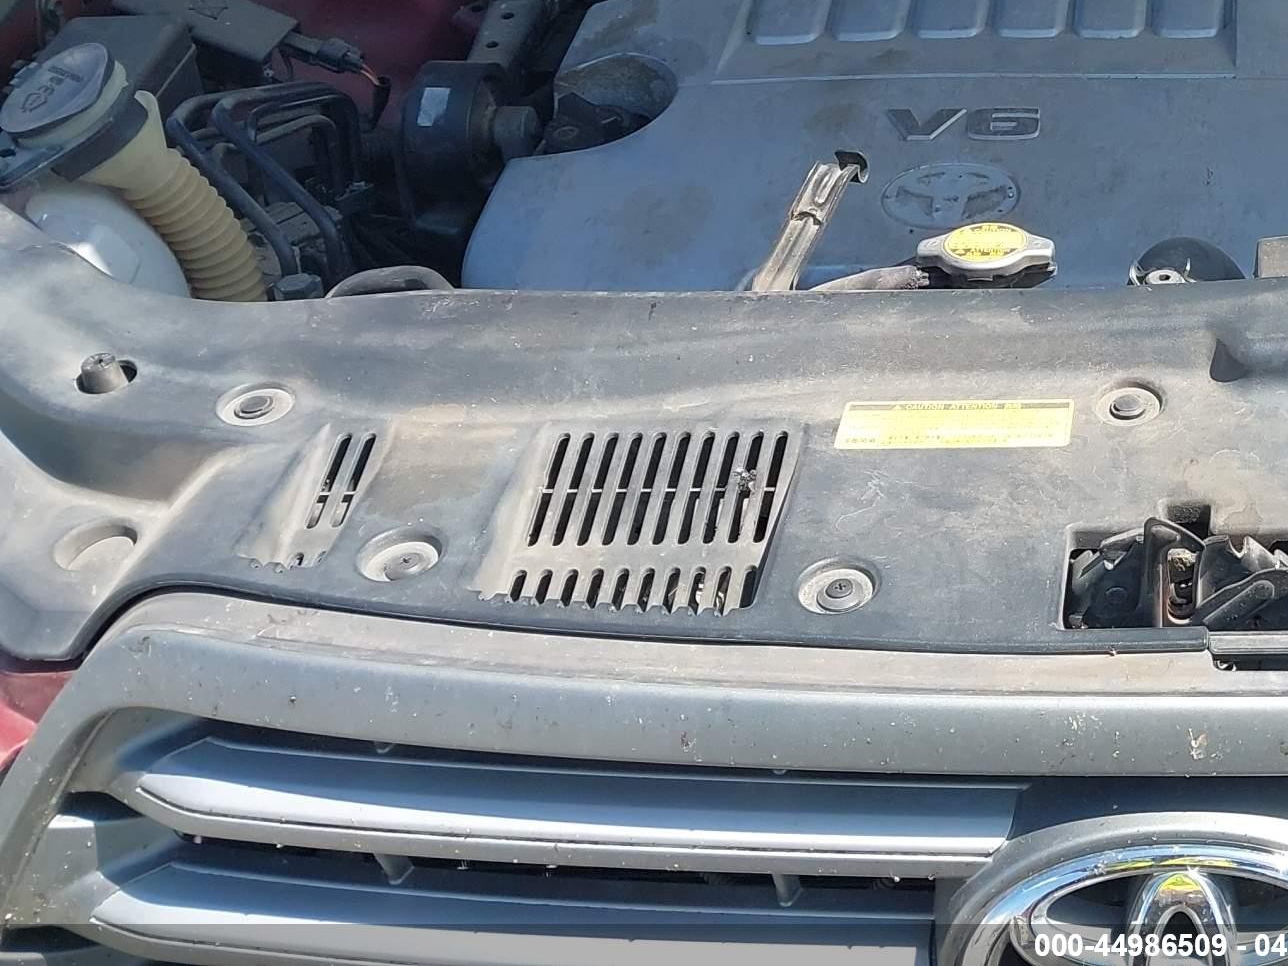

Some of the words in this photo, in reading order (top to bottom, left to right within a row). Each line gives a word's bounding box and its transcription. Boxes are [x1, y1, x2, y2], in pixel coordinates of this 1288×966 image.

[886, 107, 1041, 141] V6
[905, 403, 945, 411] CAUTION
[950, 402, 998, 410] ATTENTION
